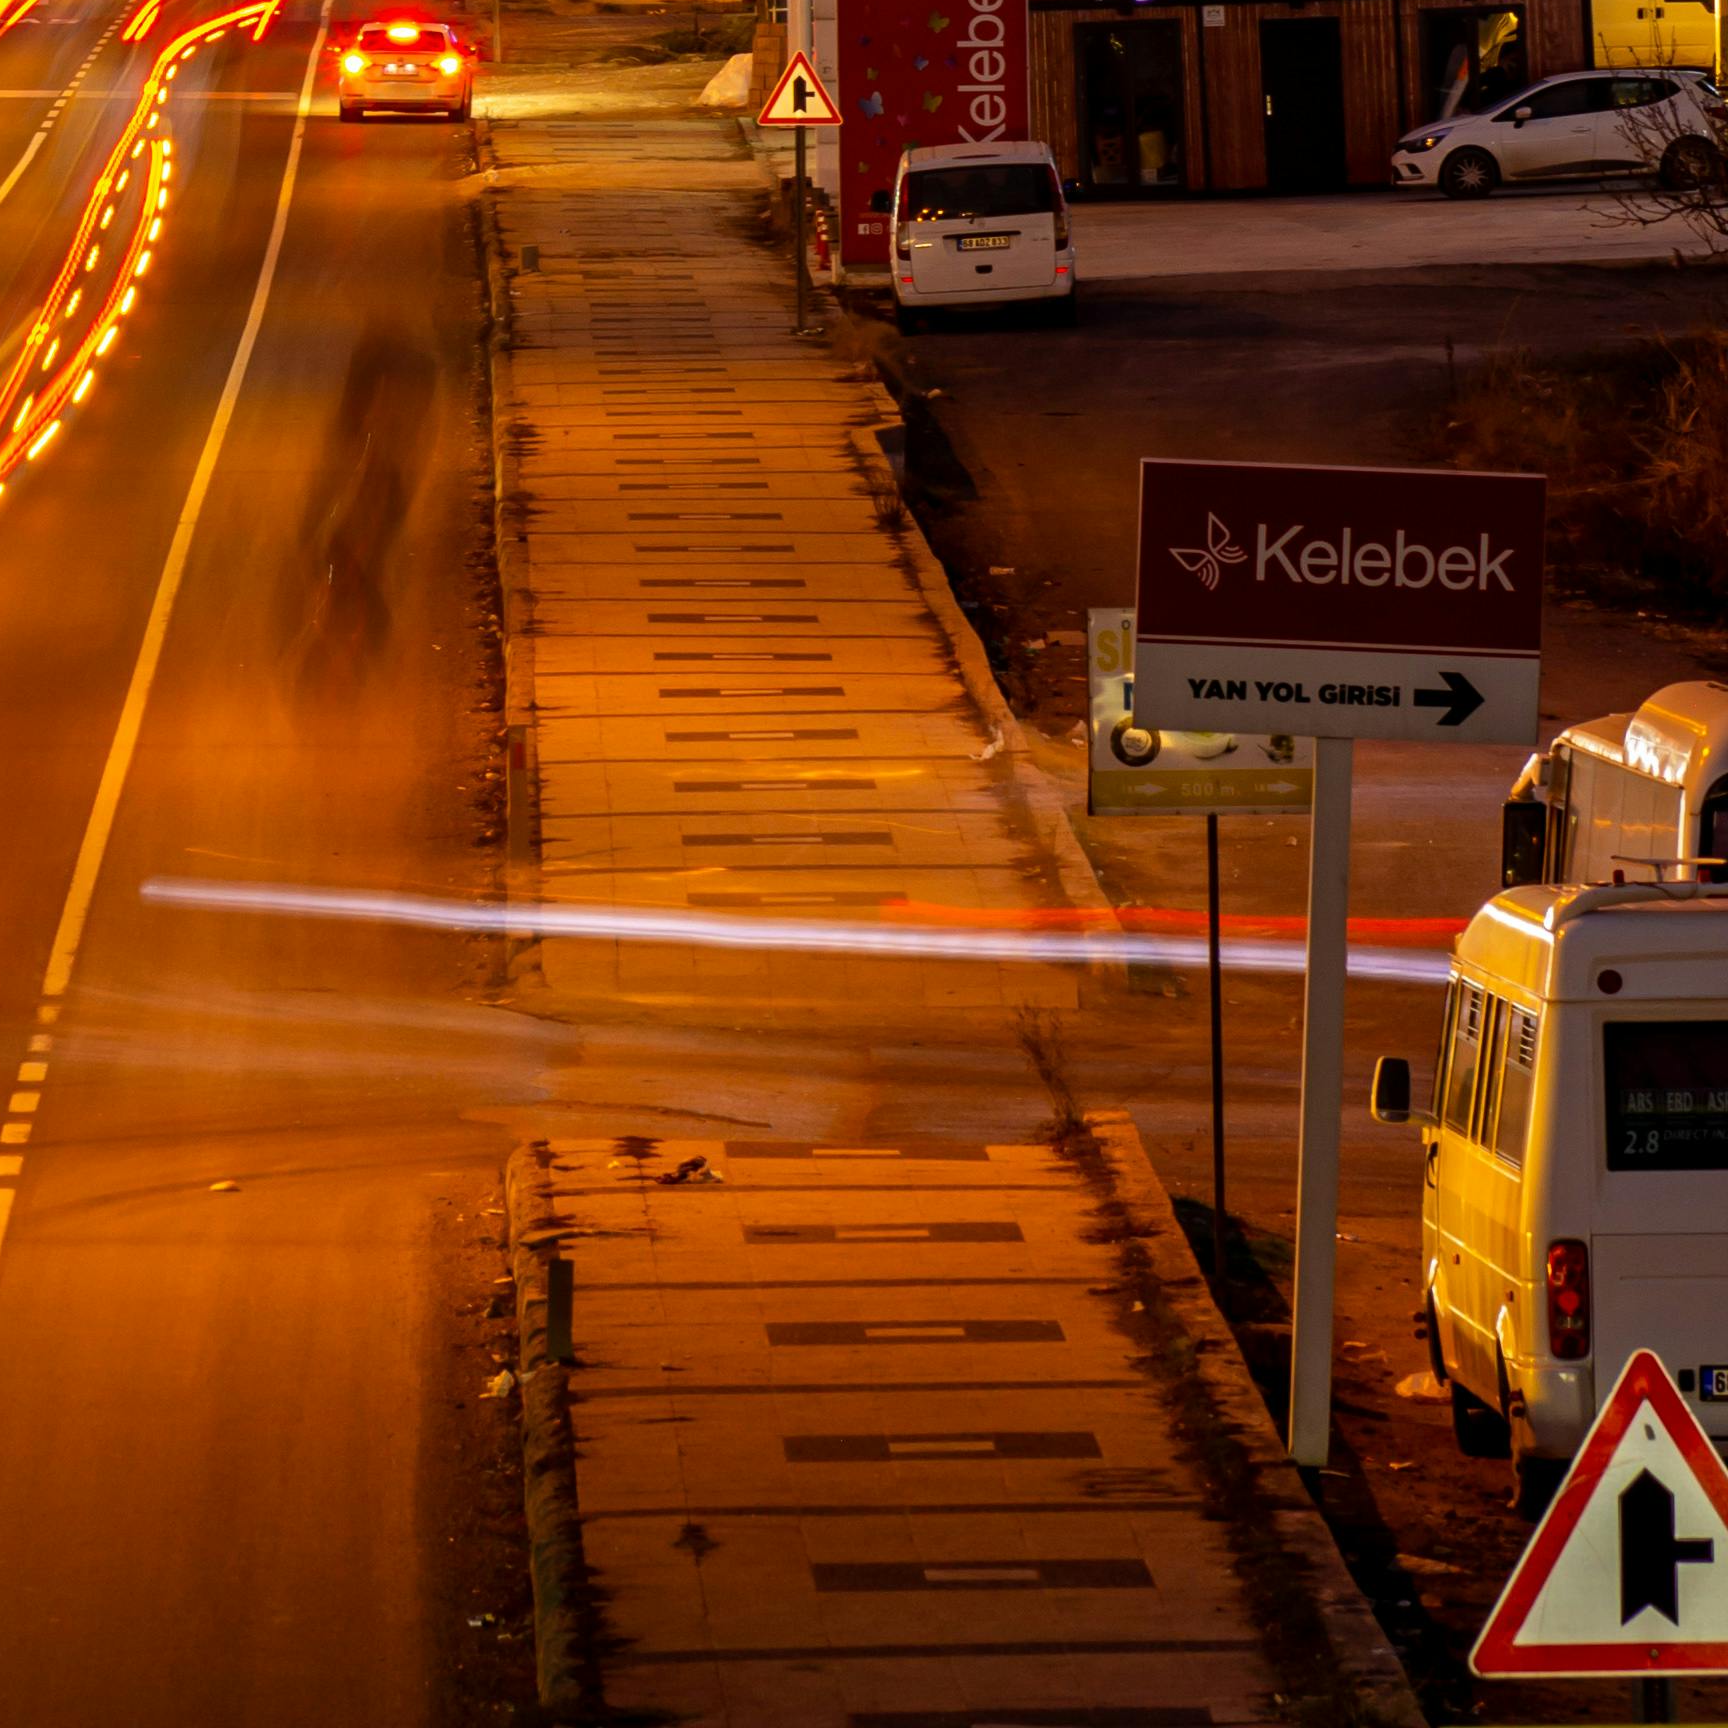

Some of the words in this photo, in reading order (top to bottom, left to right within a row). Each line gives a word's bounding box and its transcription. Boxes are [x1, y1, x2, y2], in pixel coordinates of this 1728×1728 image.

[1256, 523, 1516, 591] Kelebek
[1187, 678, 1247, 702] YAN
[1255, 682, 1311, 703] YOL
[1627, 1091, 1654, 1113] ABS
[1666, 1090, 1693, 1113] EBD
[1623, 1129, 1660, 1155] 2.8
[1663, 1128, 1709, 1141] DIRECT
